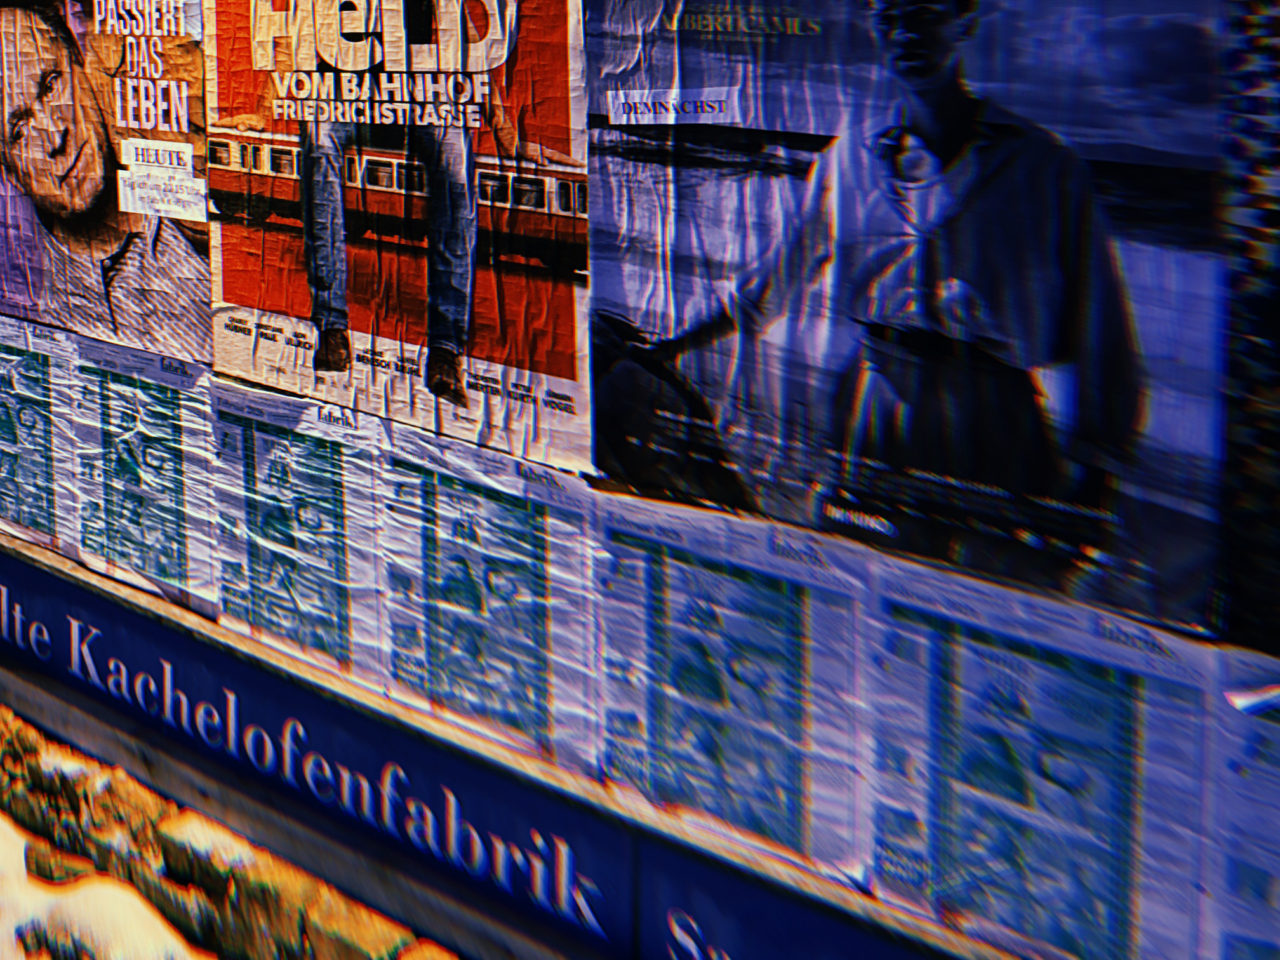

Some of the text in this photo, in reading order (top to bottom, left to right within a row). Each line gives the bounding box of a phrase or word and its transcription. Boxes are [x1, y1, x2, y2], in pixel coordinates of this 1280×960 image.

[125, 36, 163, 79] DAS
[271, 72, 490, 103] VOM BAHNHOF
[113, 77, 190, 133] LEBEN
[272, 99, 481, 128] FRIEDRICHSTRASSE
[134, 147, 188, 167] HEUTE
[225, 323, 252, 336] HÜBNER
[356, 353, 391, 370] BENESCH
[543, 398, 577, 416] VOGEL
[66, 614, 610, 941] Kachelofenfabrik
